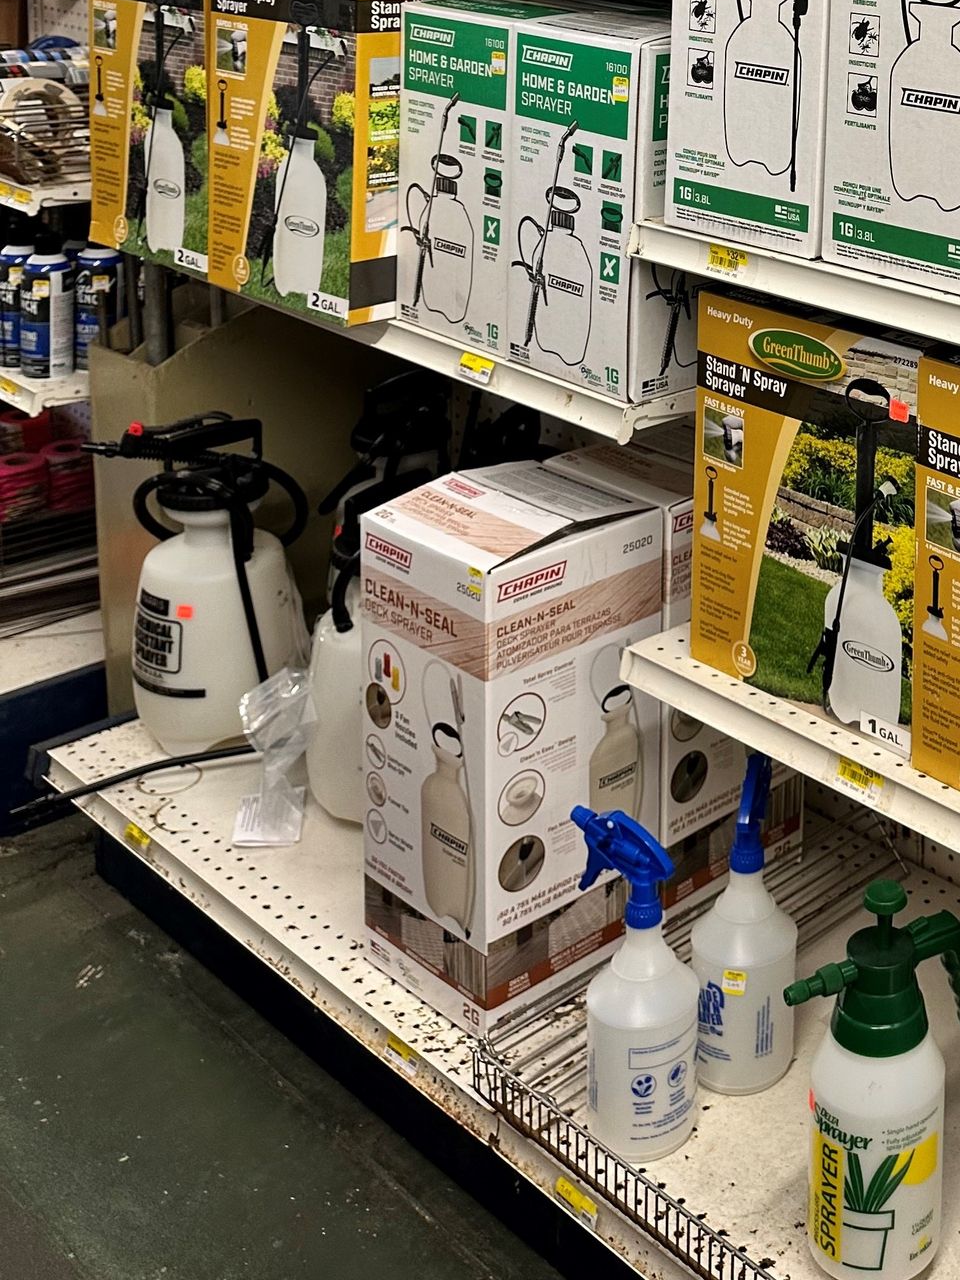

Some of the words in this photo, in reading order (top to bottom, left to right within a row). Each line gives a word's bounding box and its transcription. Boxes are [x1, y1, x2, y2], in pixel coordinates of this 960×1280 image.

[413, 29, 452, 44] CHAPIN
[485, 37, 505, 50] 16100
[409, 49, 438, 67] HOME
[440, 53, 448, 68] &
[450, 57, 493, 78] GARDEN
[525, 50, 570, 66] CHAPIN
[605, 61, 628, 75] 16100
[408, 67, 454, 89] SPRAYER
[522, 72, 554, 92] HOME
[557, 79, 565, 94] &
[568, 82, 615, 106] GARDEN
[521, 91, 572, 116] SPRAYER
[312, 292, 320, 308] 2
[707, 306, 732, 323] Heavy
[733, 314, 753, 329] Duty
[762, 336, 831, 370] GreenThumb
[893, 355, 918, 369] 272289
[705, 371, 746, 398] Sprayer
[706, 355, 736, 379] Stand
[753, 371, 787, 397] Spray
[928, 374, 960, 392] Heavy
[368, 538, 410, 565] CHAPIN
[622, 535, 653, 555] 25020
[456, 581, 481, 602] 25020
[503, 565, 563, 596] CHAPIN
[364, 598, 389, 623] DECK
[389, 609, 433, 643] SPRAYER
[365, 578, 458, 638] CLEAN-N-SEAL
[496, 600, 576, 639] CLEAN-N-SEAL
[814, 1101, 873, 1151] Sprayer
[820, 1107, 839, 1127] DELTA
[820, 1143, 838, 1257] SPRAYER
